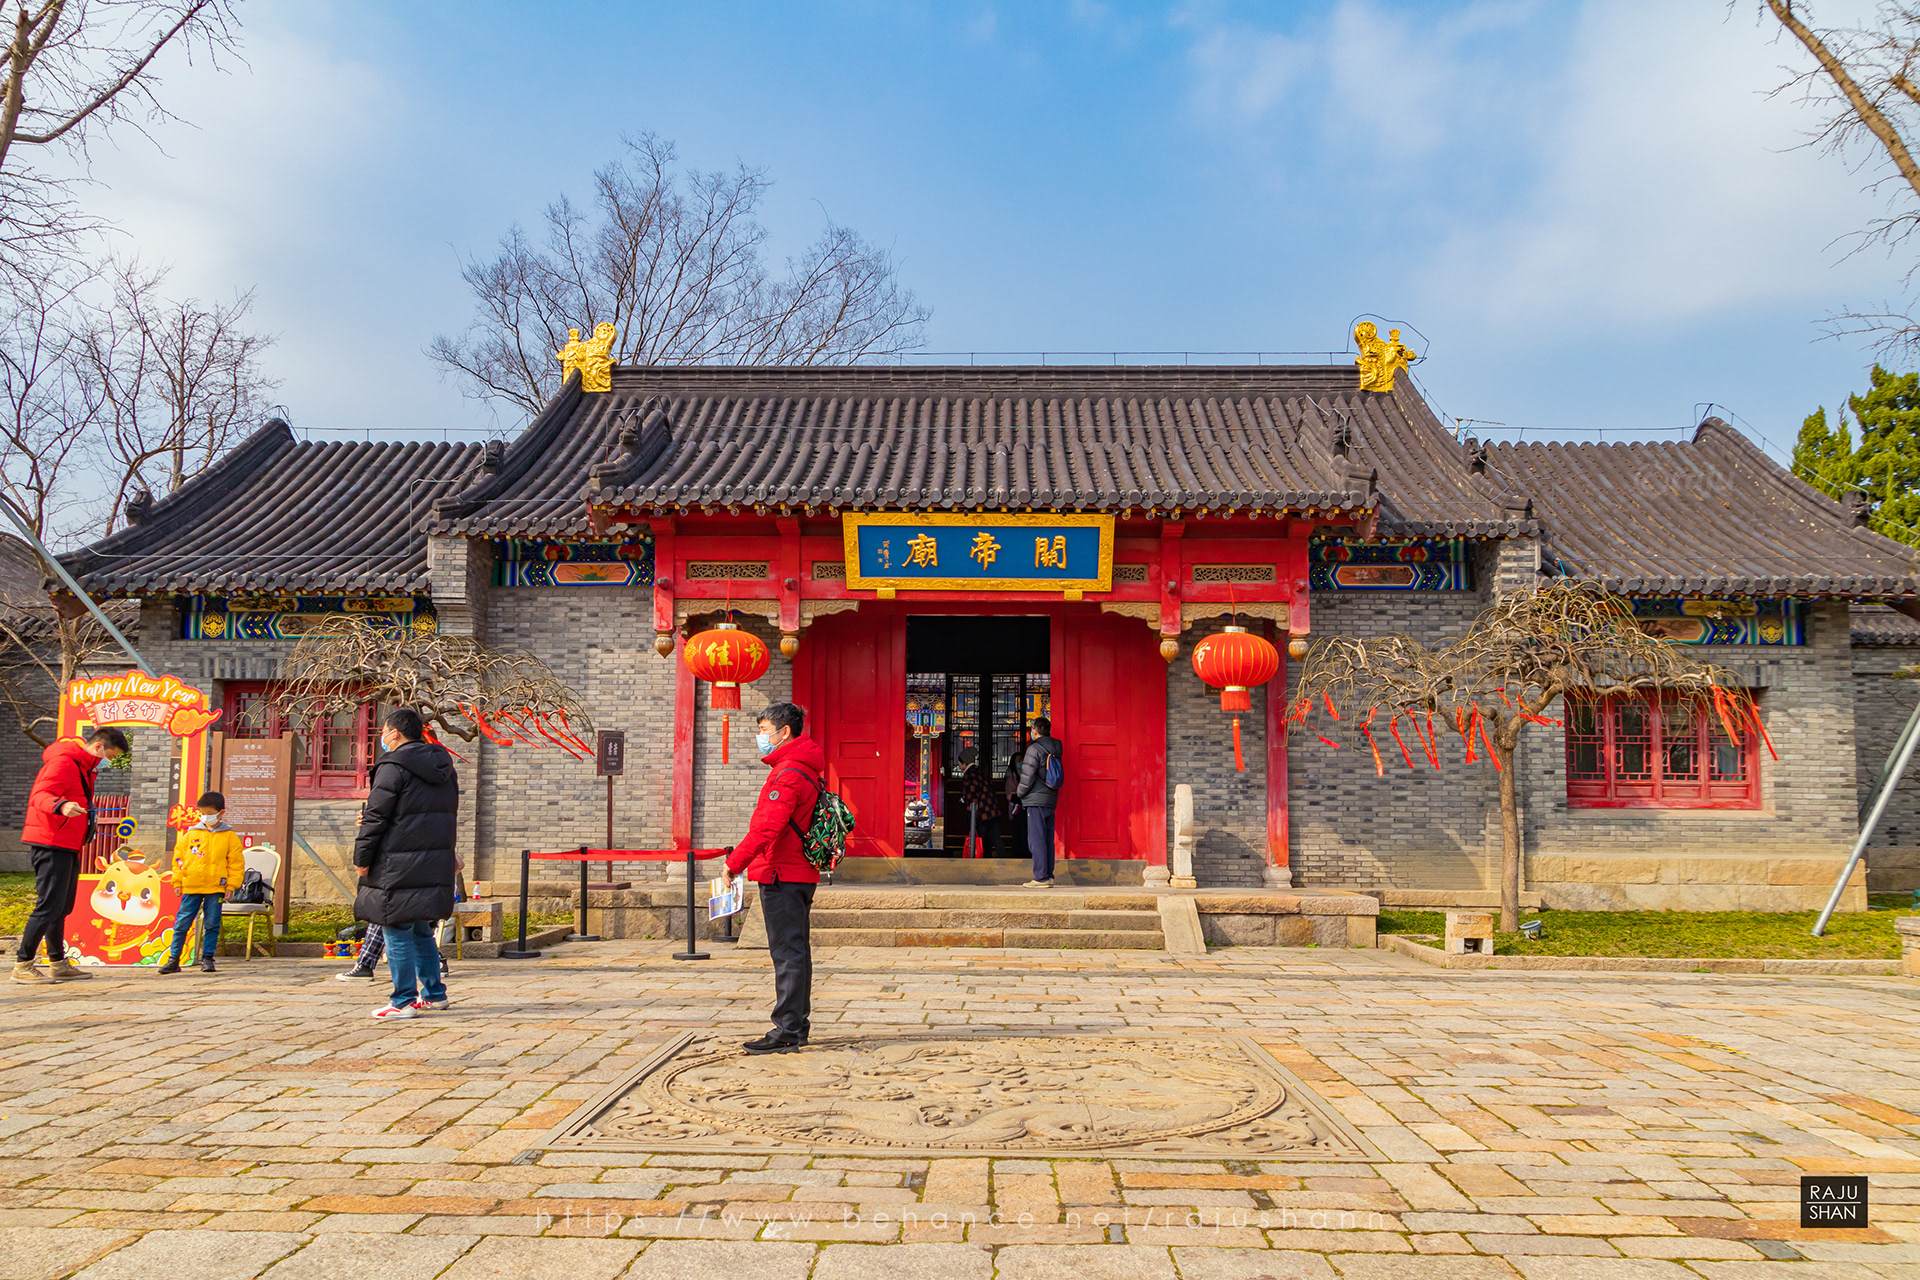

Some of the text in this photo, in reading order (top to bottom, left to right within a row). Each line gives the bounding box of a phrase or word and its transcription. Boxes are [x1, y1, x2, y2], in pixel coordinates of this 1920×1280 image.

[705, 640, 764, 669] 佳节
[72, 676, 197, 703] Happy New Year
[102, 701, 161, 721] 抖空竹
